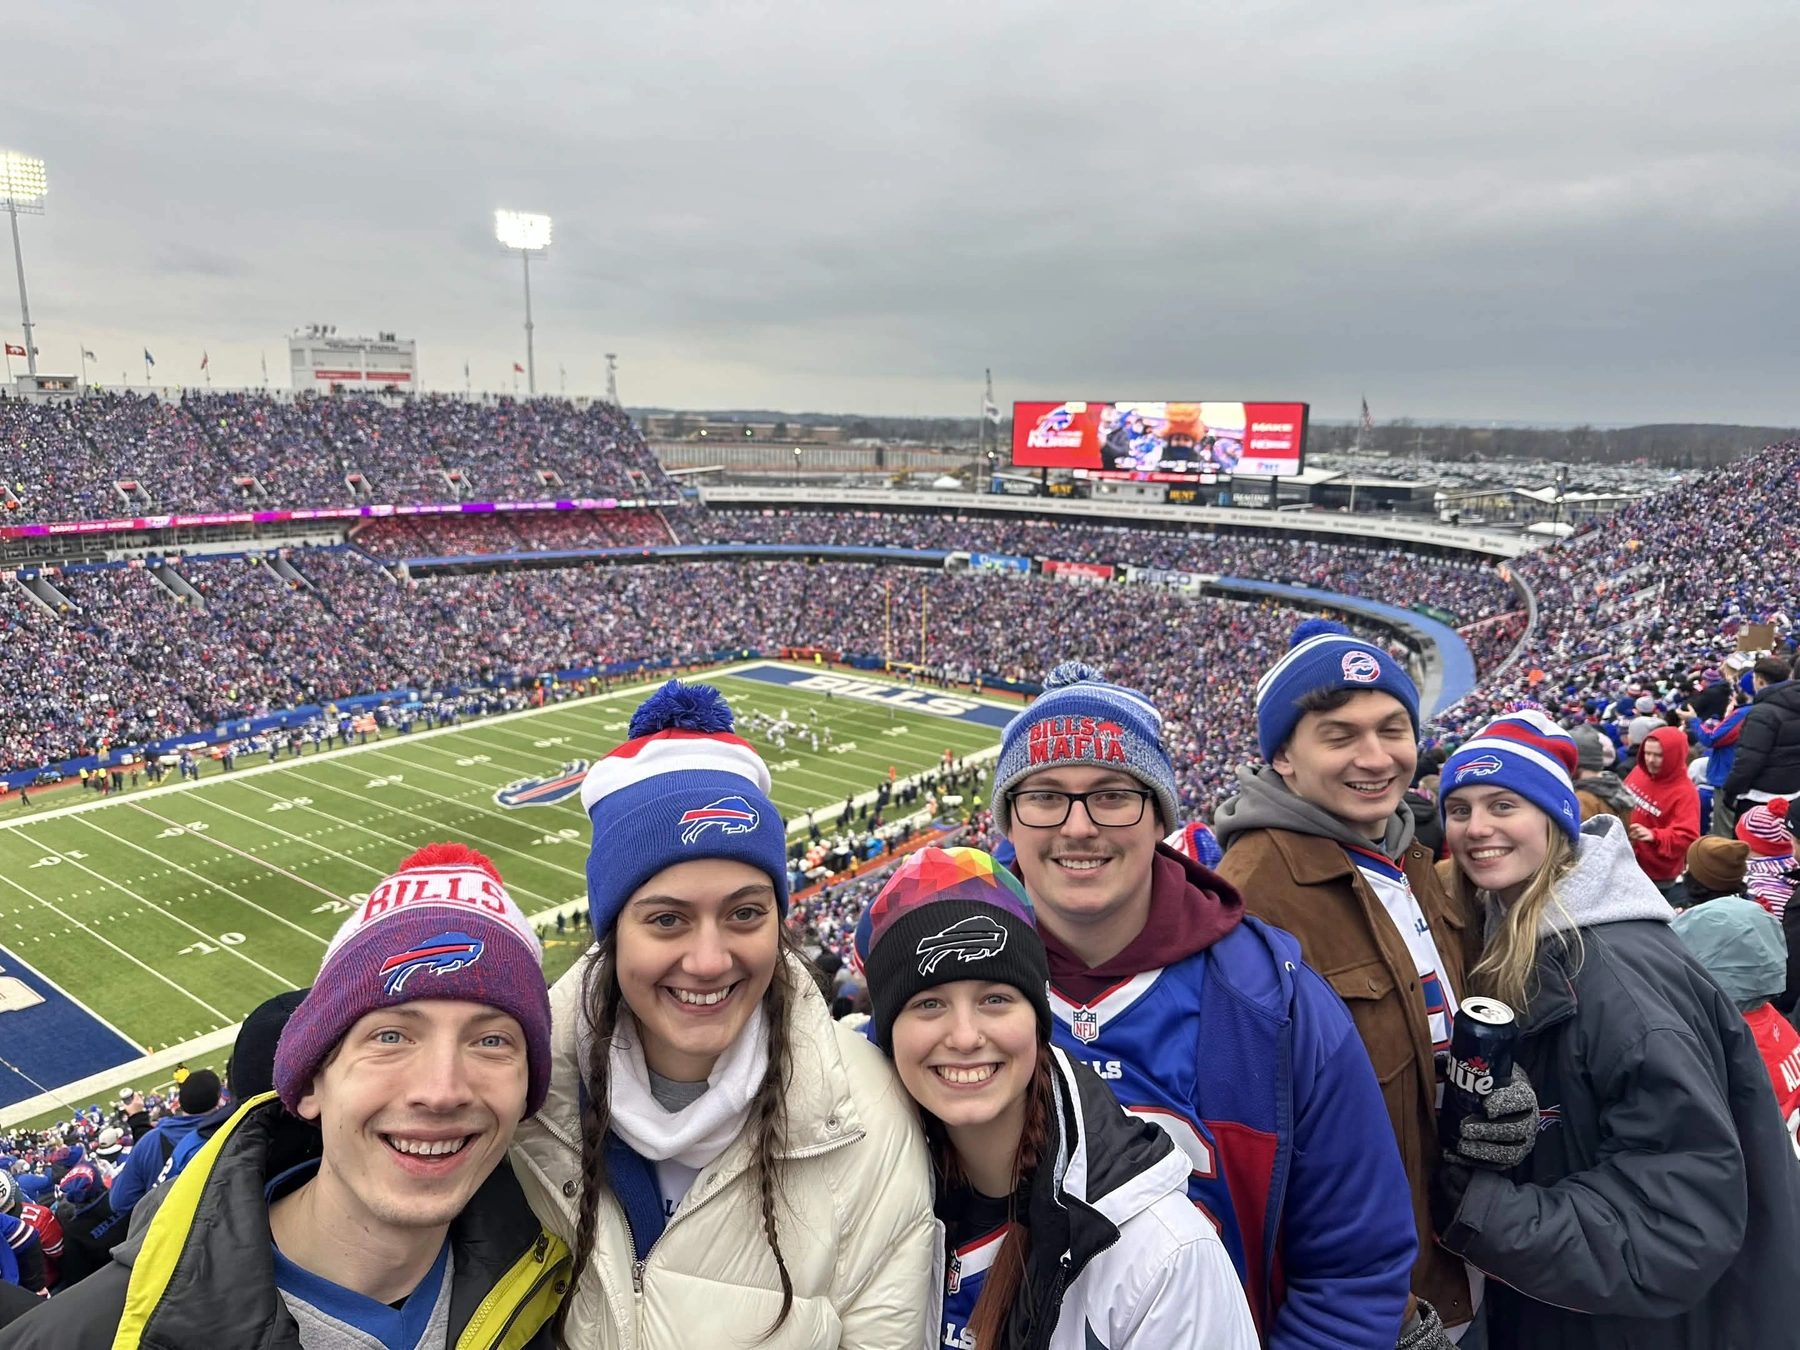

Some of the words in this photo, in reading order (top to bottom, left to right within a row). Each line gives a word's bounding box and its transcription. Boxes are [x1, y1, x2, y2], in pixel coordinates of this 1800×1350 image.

[788, 675, 981, 717] BILLS
[1029, 717, 1096, 742] BILLS
[1029, 736, 1126, 766] MAFIA
[162, 821, 210, 838] 20
[38, 849, 90, 867] 10
[360, 877, 507, 926] BILLS
[189, 931, 247, 956] 10
[1075, 1022, 1096, 1038] NFL
[20, 1204, 42, 1223] 17
